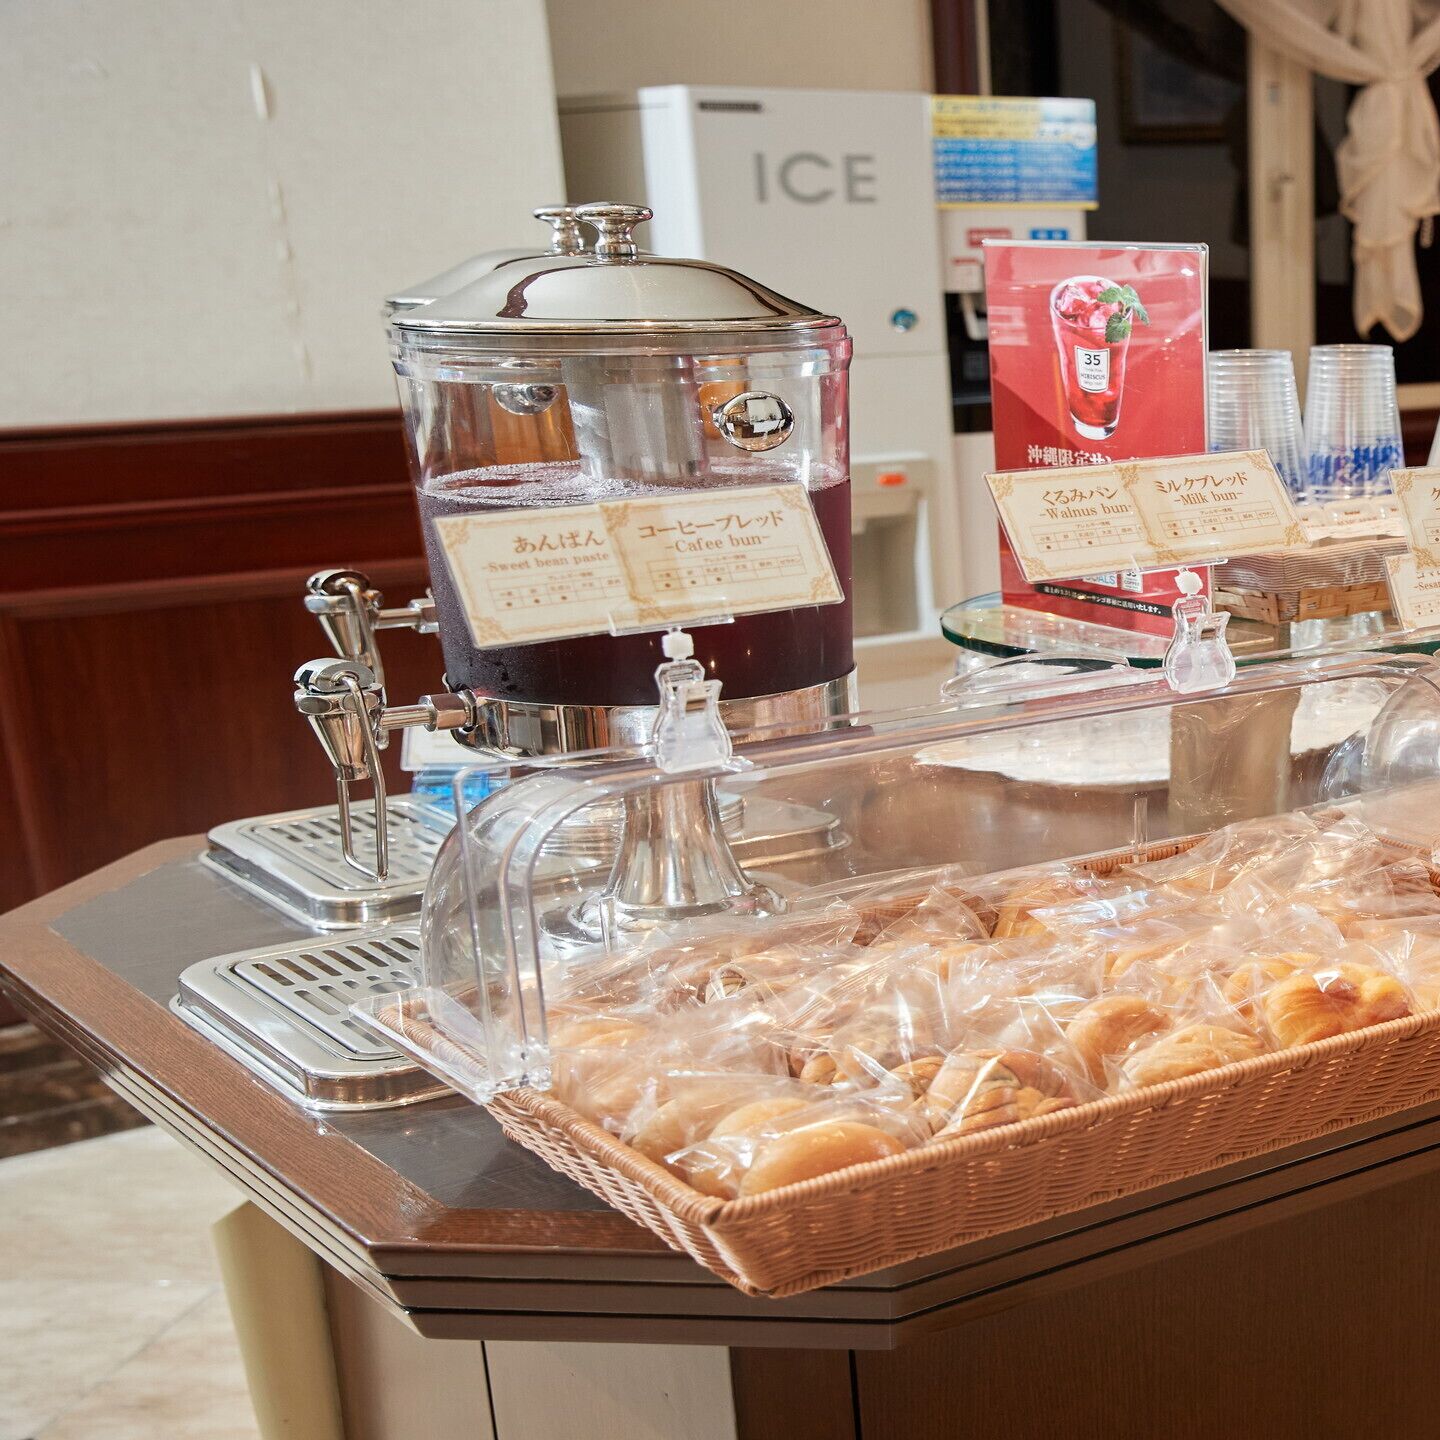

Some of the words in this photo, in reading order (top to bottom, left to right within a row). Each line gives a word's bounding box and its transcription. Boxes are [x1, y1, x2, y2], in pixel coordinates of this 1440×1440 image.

[755, 152, 877, 205] ICE
[1084, 353, 1101, 366] 35
[1154, 471, 1248, 493] ミルクブレッド
[1042, 486, 1119, 506] くるみパン
[637, 509, 784, 538] コーヒーブレッド
[535, 556, 569, 568] bean
